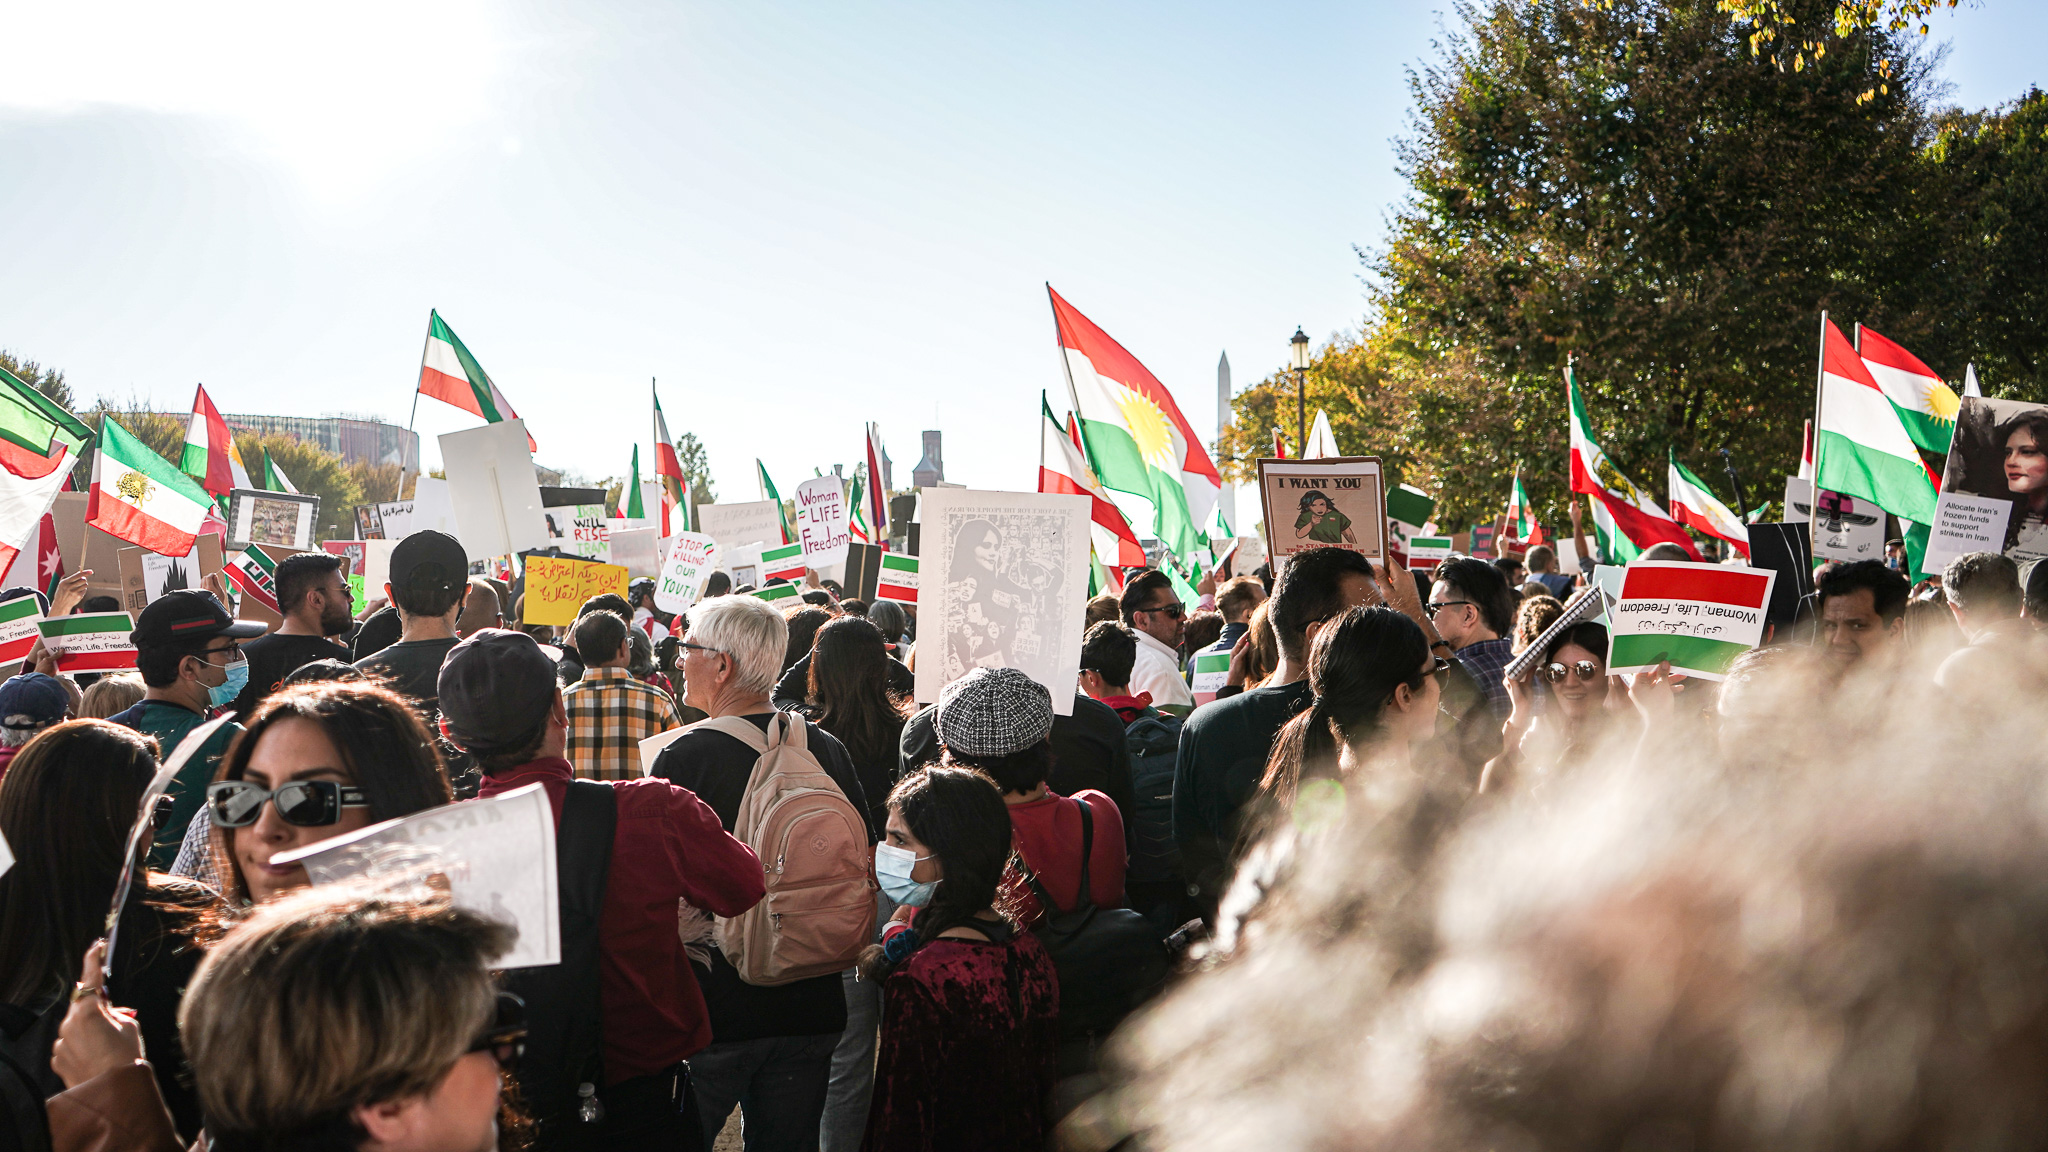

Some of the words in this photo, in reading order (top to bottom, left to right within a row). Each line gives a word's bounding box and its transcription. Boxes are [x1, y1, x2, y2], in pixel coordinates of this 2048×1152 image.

[1278, 477, 1285, 489] I
[1288, 477, 1329, 489] WANT
[1333, 477, 1362, 489] YOU
[799, 488, 838, 506] Woman
[576, 504, 604, 518] IRAN
[810, 504, 840, 523] LIFE
[1945, 502, 1976, 512] Allocate
[1977, 506, 1999, 515] Iran's
[573, 518, 606, 528] WILL
[1943, 510, 1967, 521] frozen
[1968, 514, 1990, 524] funds
[1950, 521, 1979, 532] support
[574, 528, 611, 542] RISE
[802, 526, 849, 555] Freedom
[1940, 529, 1964, 539] strikes
[1974, 534, 1990, 542] Iran
[576, 542, 608, 556] IRAN
[677, 538, 703, 552] STOP
[673, 550, 705, 566] KILLING
[675, 564, 696, 579] OUR
[662, 576, 697, 600] YOUTH
[1620, 603, 1671, 614] Freedom
[1675, 602, 1700, 616] Life,
[1704, 604, 1757, 624] Woman,
[9, 627, 38, 638] Freedo
